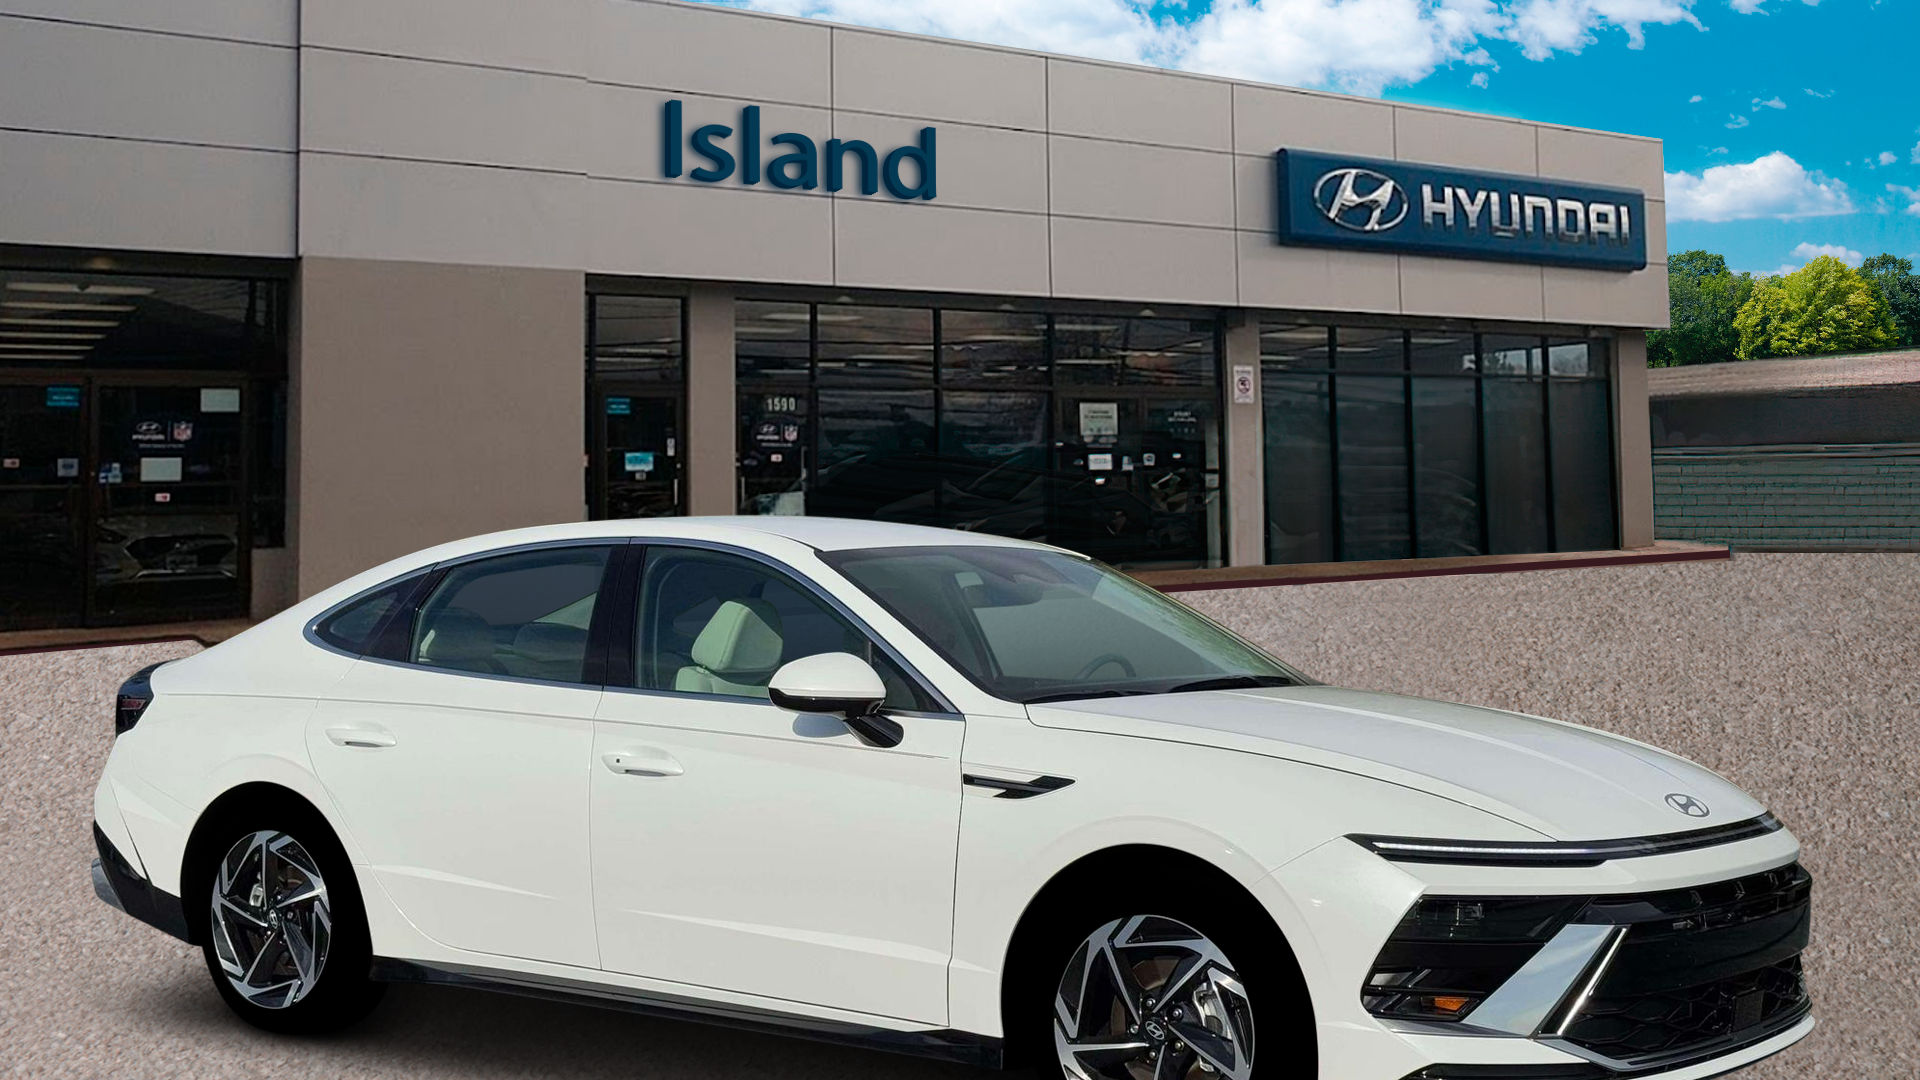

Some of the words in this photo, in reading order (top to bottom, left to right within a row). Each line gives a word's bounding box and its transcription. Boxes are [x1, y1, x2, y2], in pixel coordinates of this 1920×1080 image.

[664, 99, 937, 200] Island
[1421, 183, 1631, 247] HYUNDAI
[766, 397, 796, 411] 1590
